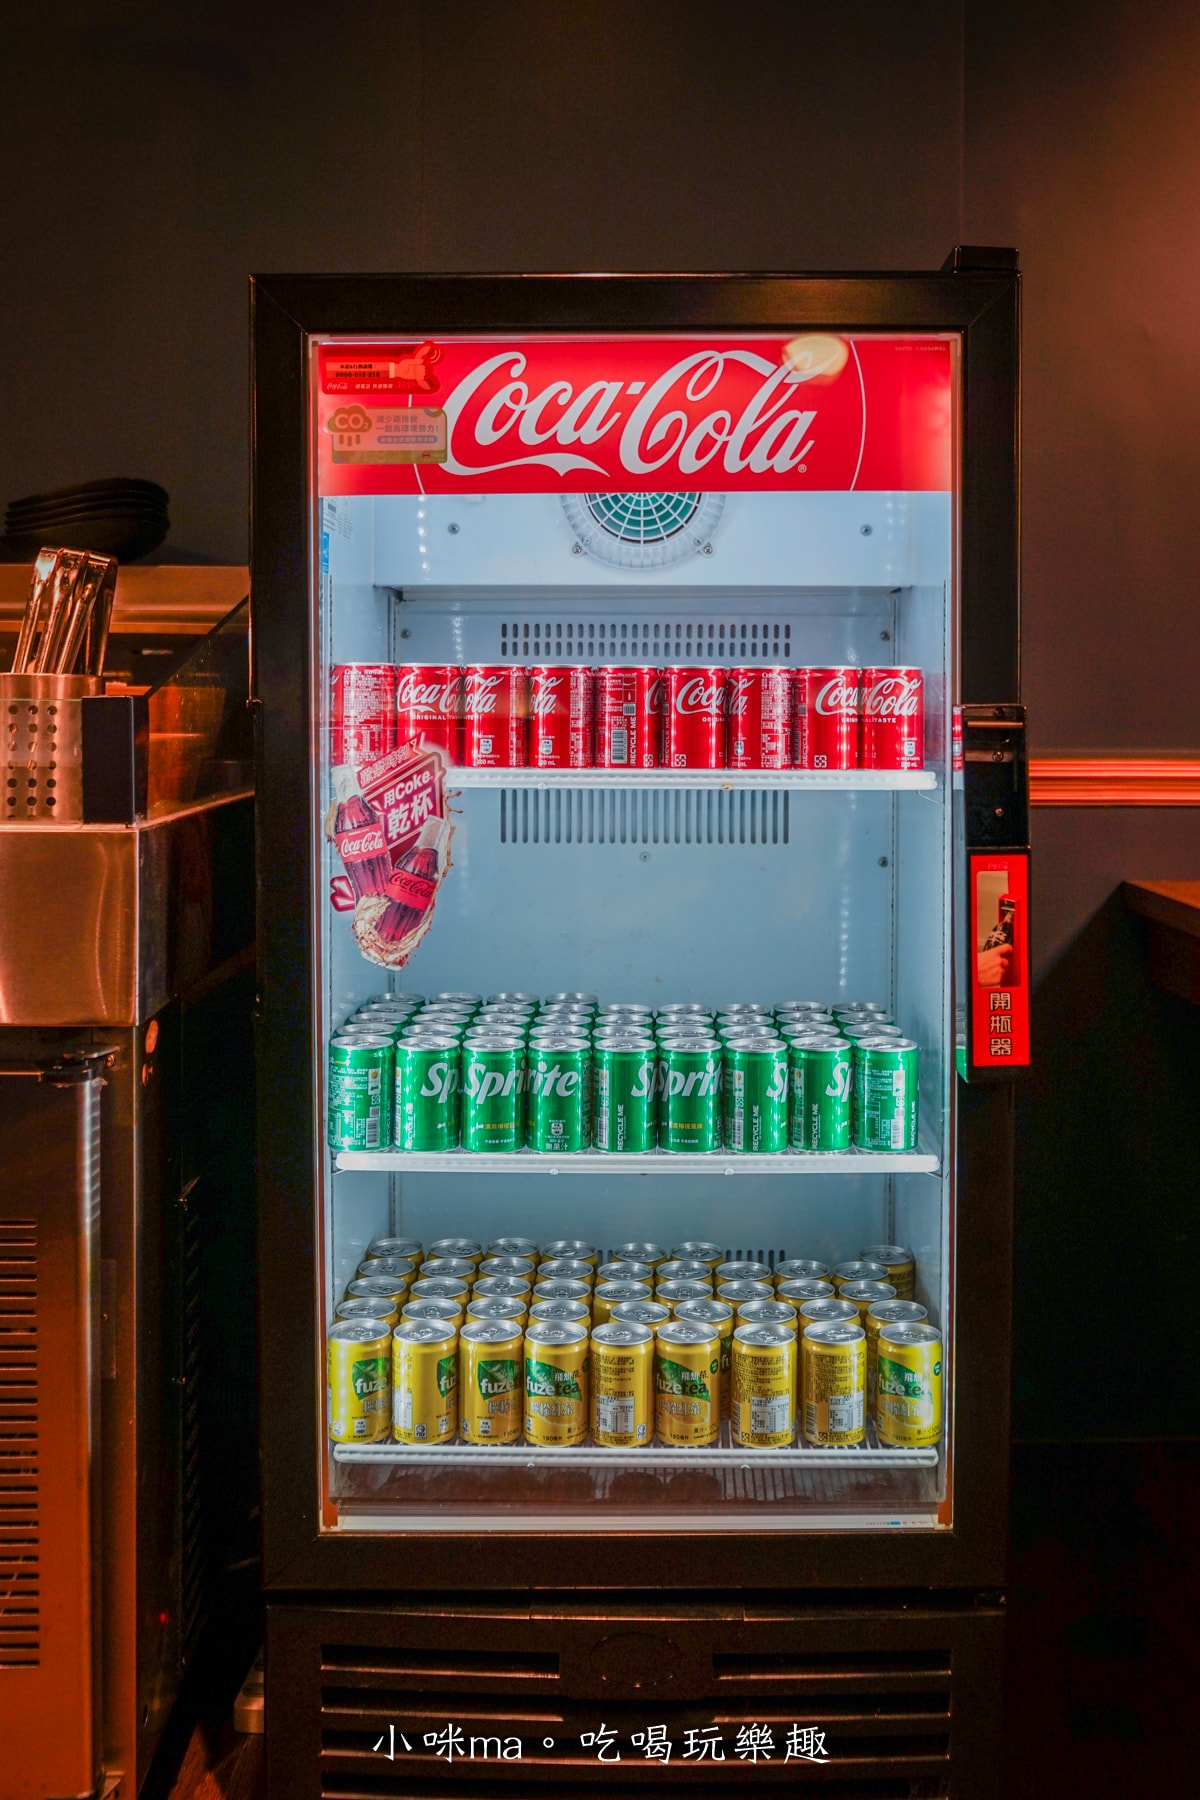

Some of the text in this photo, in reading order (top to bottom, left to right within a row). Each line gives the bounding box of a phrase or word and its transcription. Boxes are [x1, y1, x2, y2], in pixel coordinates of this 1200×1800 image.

[438, 350, 840, 476] Coca-Cola
[388, 786, 434, 840] 乾杯
[340, 831, 384, 858] Coca-Cola
[389, 871, 434, 899] Coca-Cola
[990, 992, 1012, 1056] 開瓶器
[617, 1103, 624, 1115] ME
